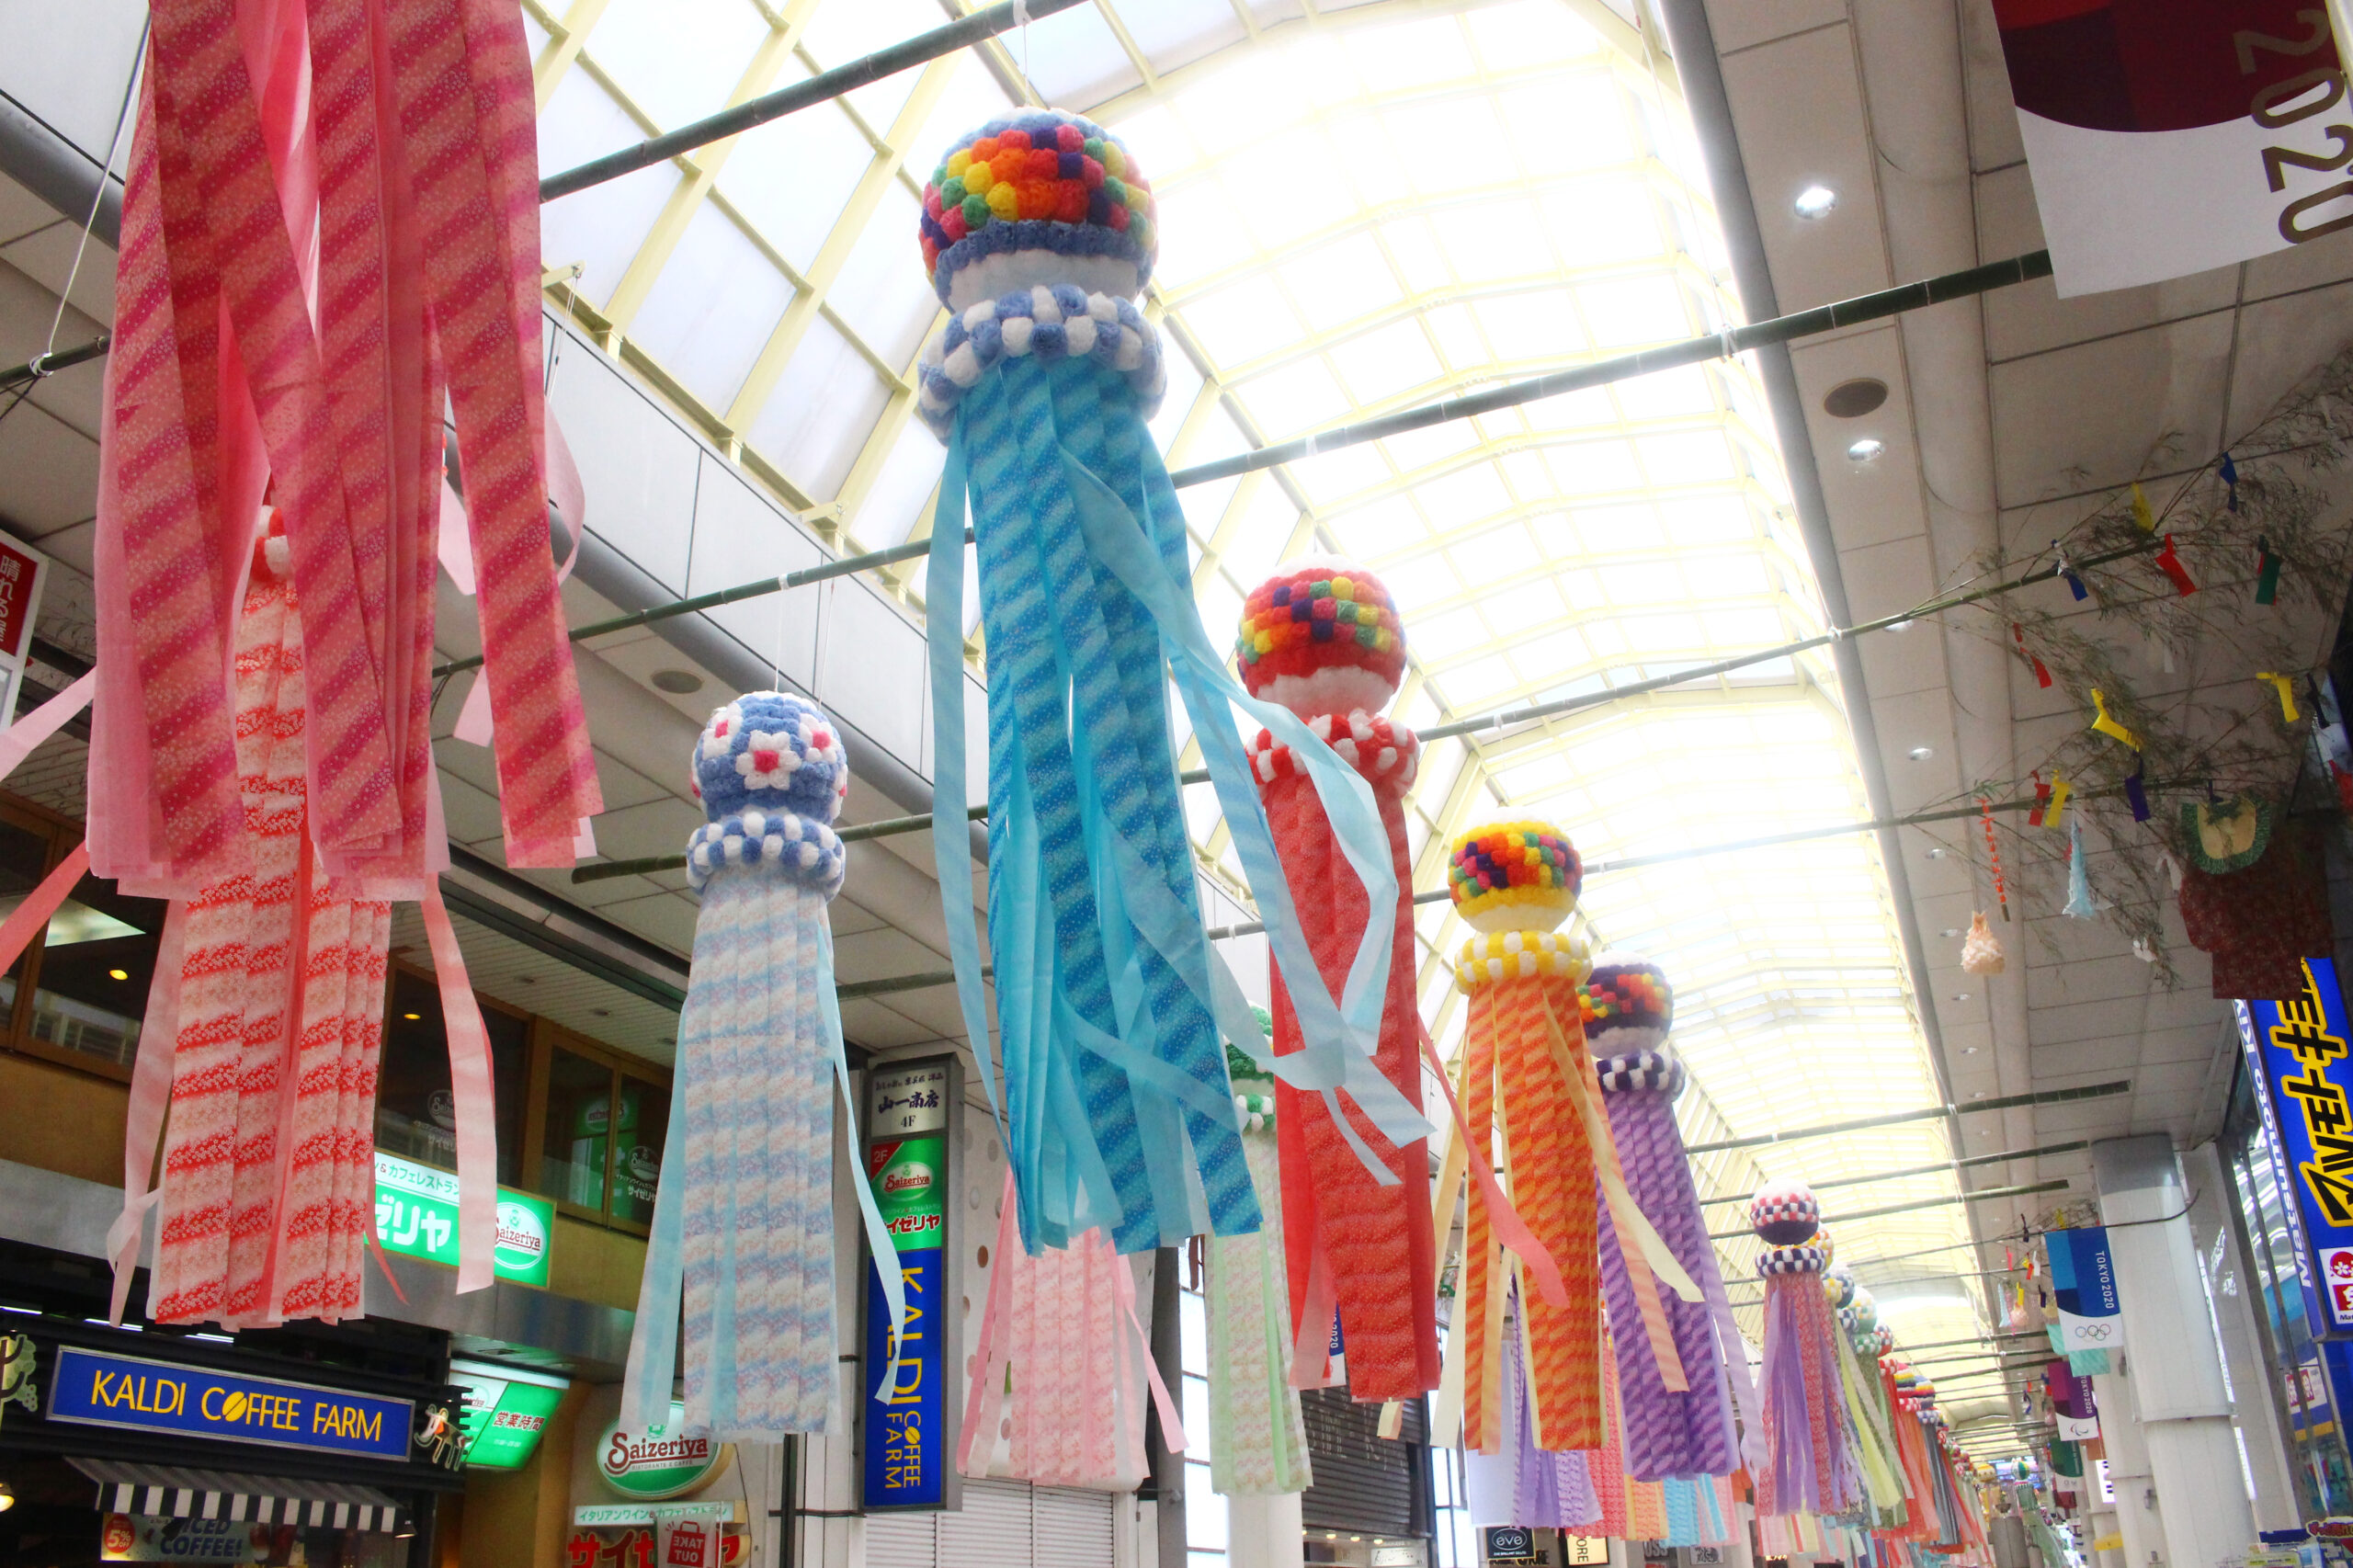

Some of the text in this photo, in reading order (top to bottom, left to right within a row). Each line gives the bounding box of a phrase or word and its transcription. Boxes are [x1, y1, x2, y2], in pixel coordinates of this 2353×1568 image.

[2234, 9, 2353, 244] 2020
[878, 1089, 939, 1114] 山一商店
[900, 1115, 915, 1128] 4F
[873, 1149, 889, 1164] 2F
[884, 1175, 930, 1192] Saizeriya
[2255, 1069, 2311, 1289] Matsumoto
[883, 1213, 941, 1234] イゼリヤ
[2096, 1250, 2115, 1309] TOKYO 2020
[886, 1266, 924, 1405] KALDI
[91, 1369, 382, 1442] KALDI COFFEE FARM
[493, 1411, 545, 1432] 営業時間
[608, 1431, 708, 1469] Saizeriya
[884, 1413, 903, 1489] FARM
[904, 1410, 922, 1489] COFFEE
[108, 1528, 131, 1548] 5%
[160, 1536, 244, 1557] COFFEE!
[1576, 1539, 1589, 1563] ORE
